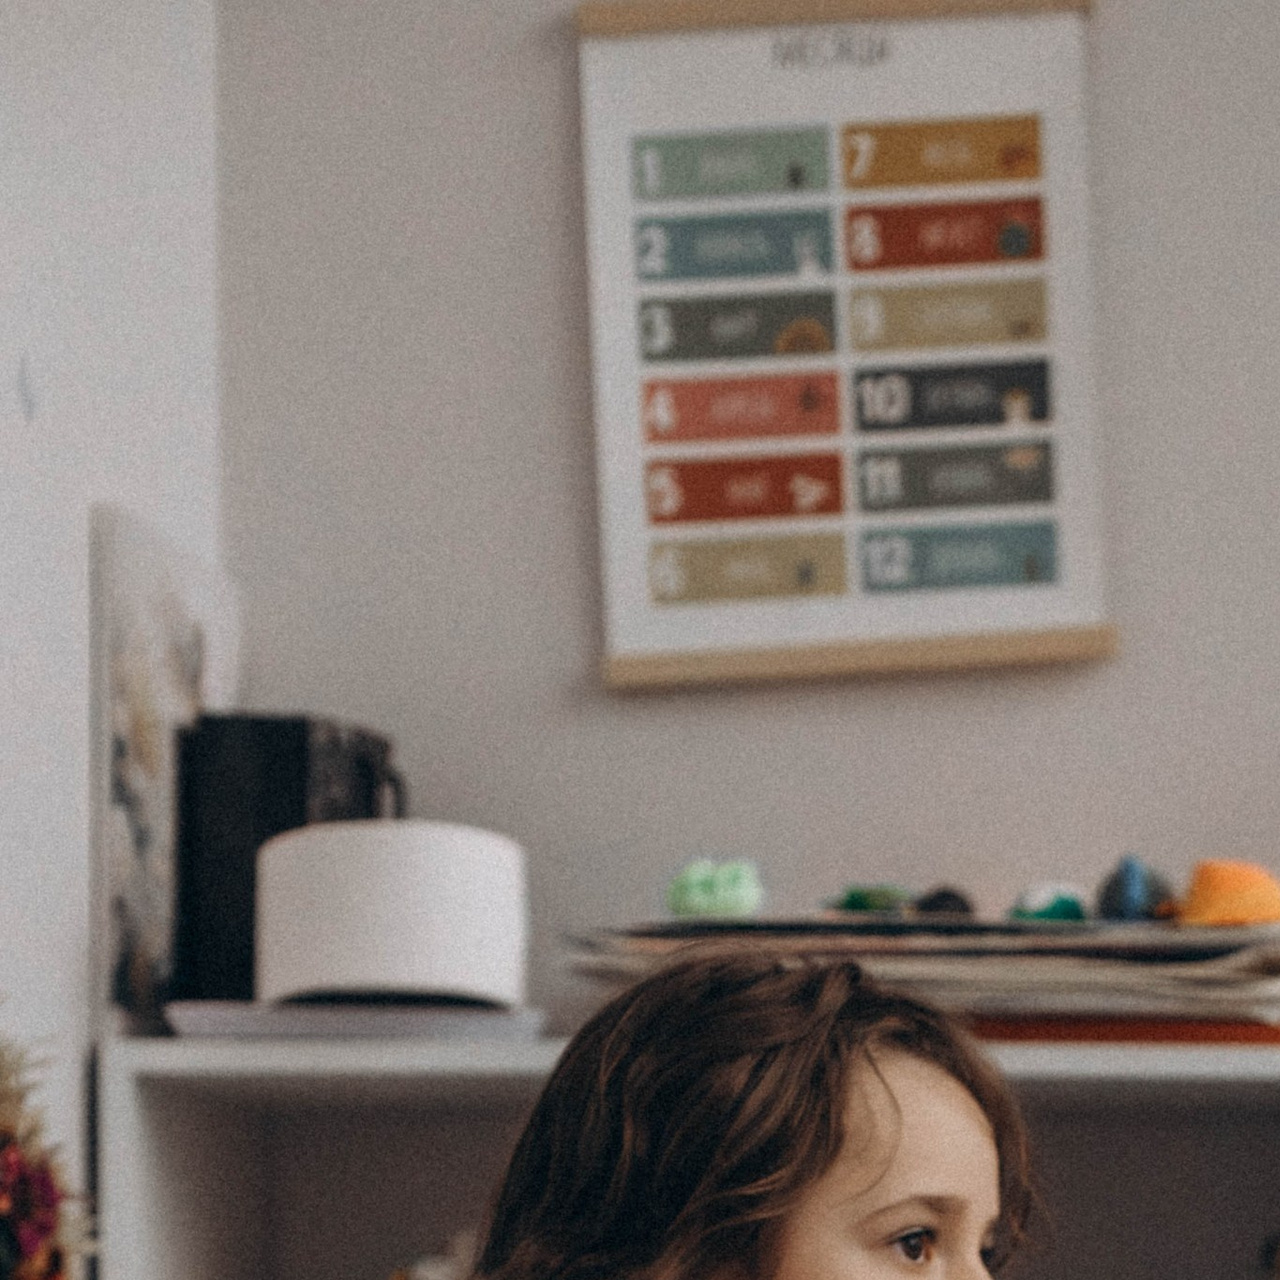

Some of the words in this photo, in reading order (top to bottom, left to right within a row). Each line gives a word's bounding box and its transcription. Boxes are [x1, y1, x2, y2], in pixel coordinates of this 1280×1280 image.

[643, 148, 661, 192] 1
[849, 131, 877, 180] 7
[640, 226, 667, 274] 2
[643, 304, 672, 353] 3
[860, 374, 912, 424] 10
[865, 457, 903, 500] 11
[865, 536, 911, 583] 12
